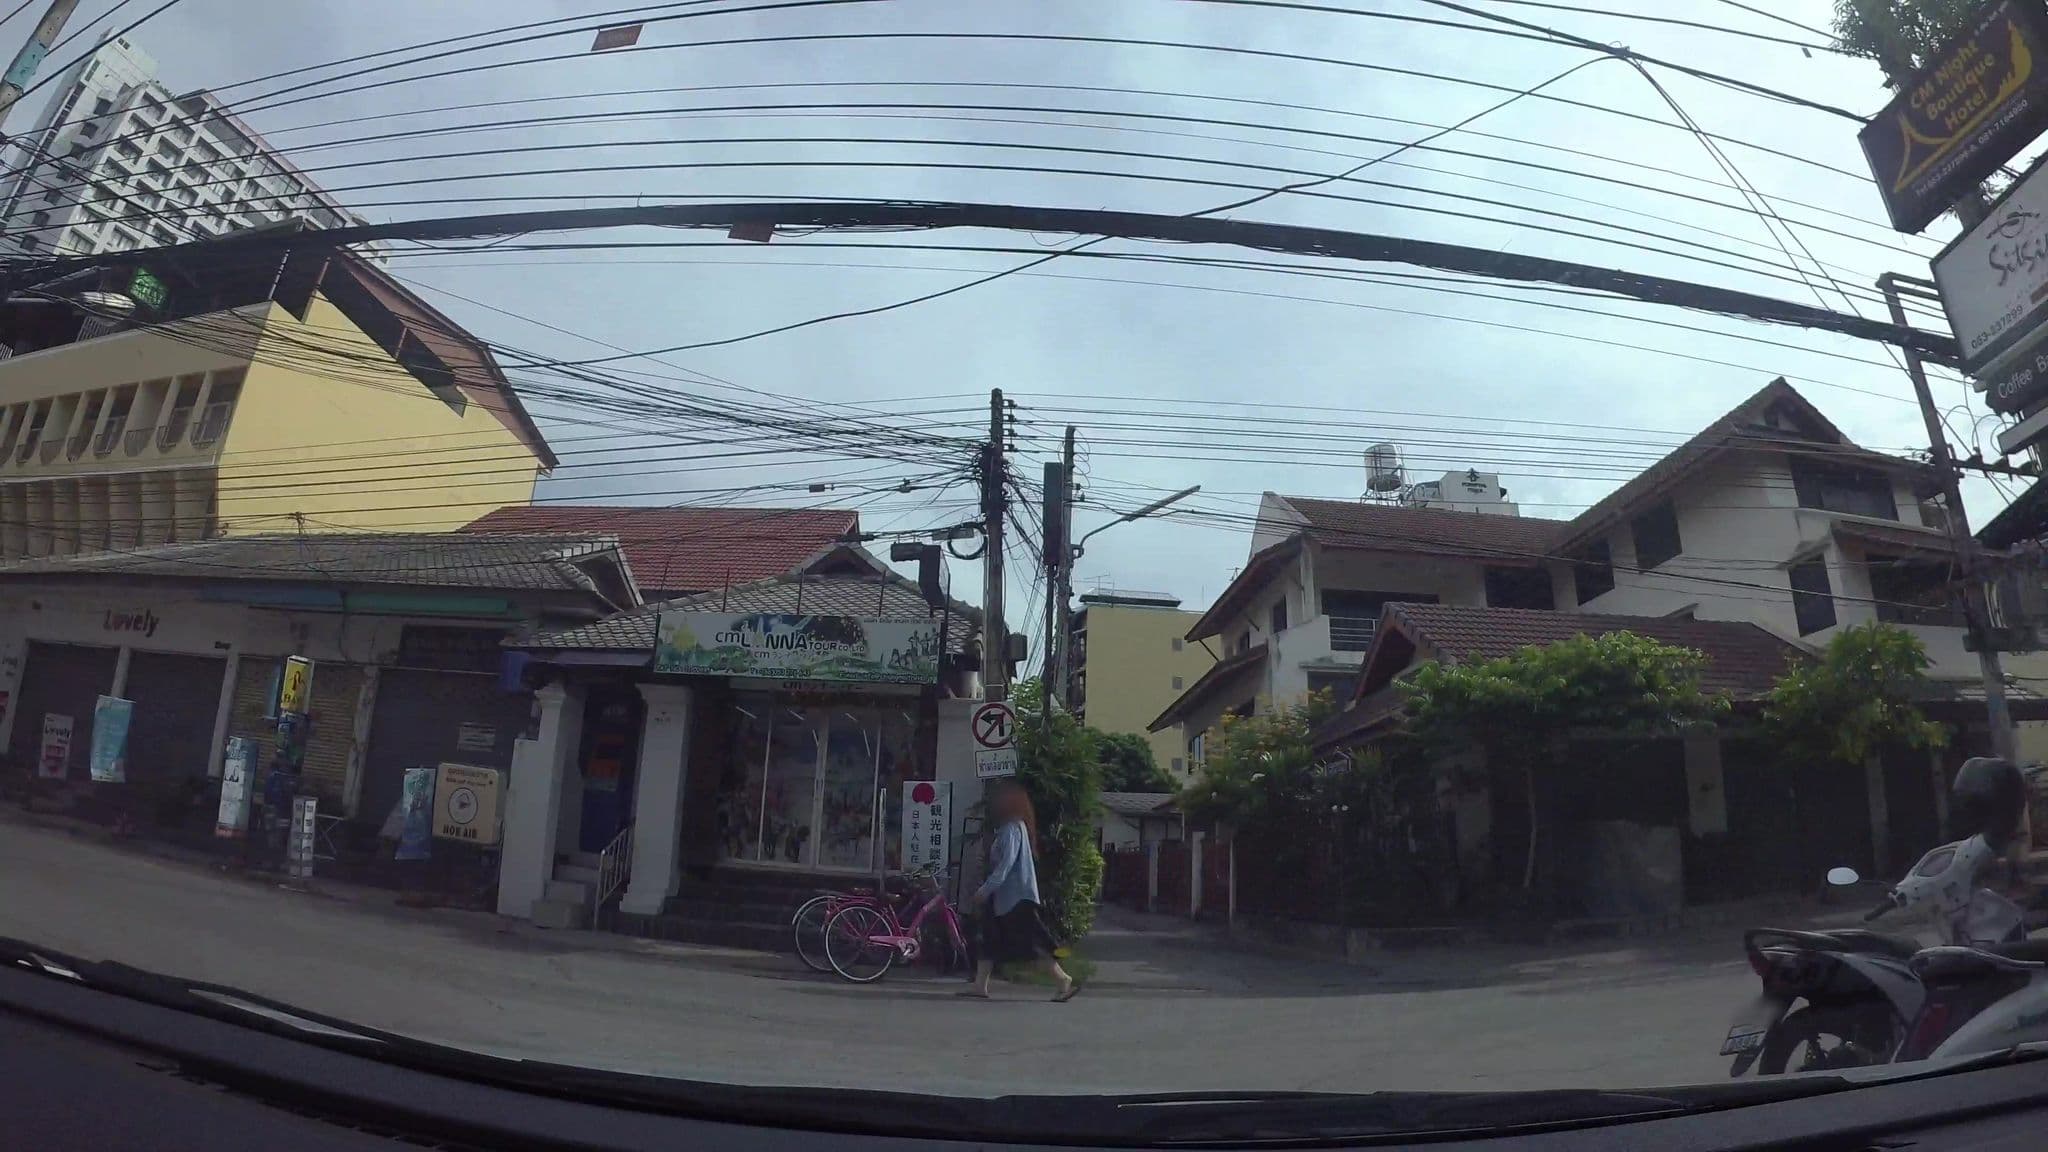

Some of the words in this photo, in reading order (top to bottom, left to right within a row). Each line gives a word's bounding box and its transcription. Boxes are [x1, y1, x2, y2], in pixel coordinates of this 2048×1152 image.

[1911, 80, 1936, 109] CM
[1936, 40, 1979, 84] Night
[1926, 53, 1996, 121] Boutique
[1944, 88, 1989, 130] Hotel
[1998, 365, 2033, 400] Coffee
[104, 608, 160, 638] Lovely
[809, 639, 837, 651] TOUR
